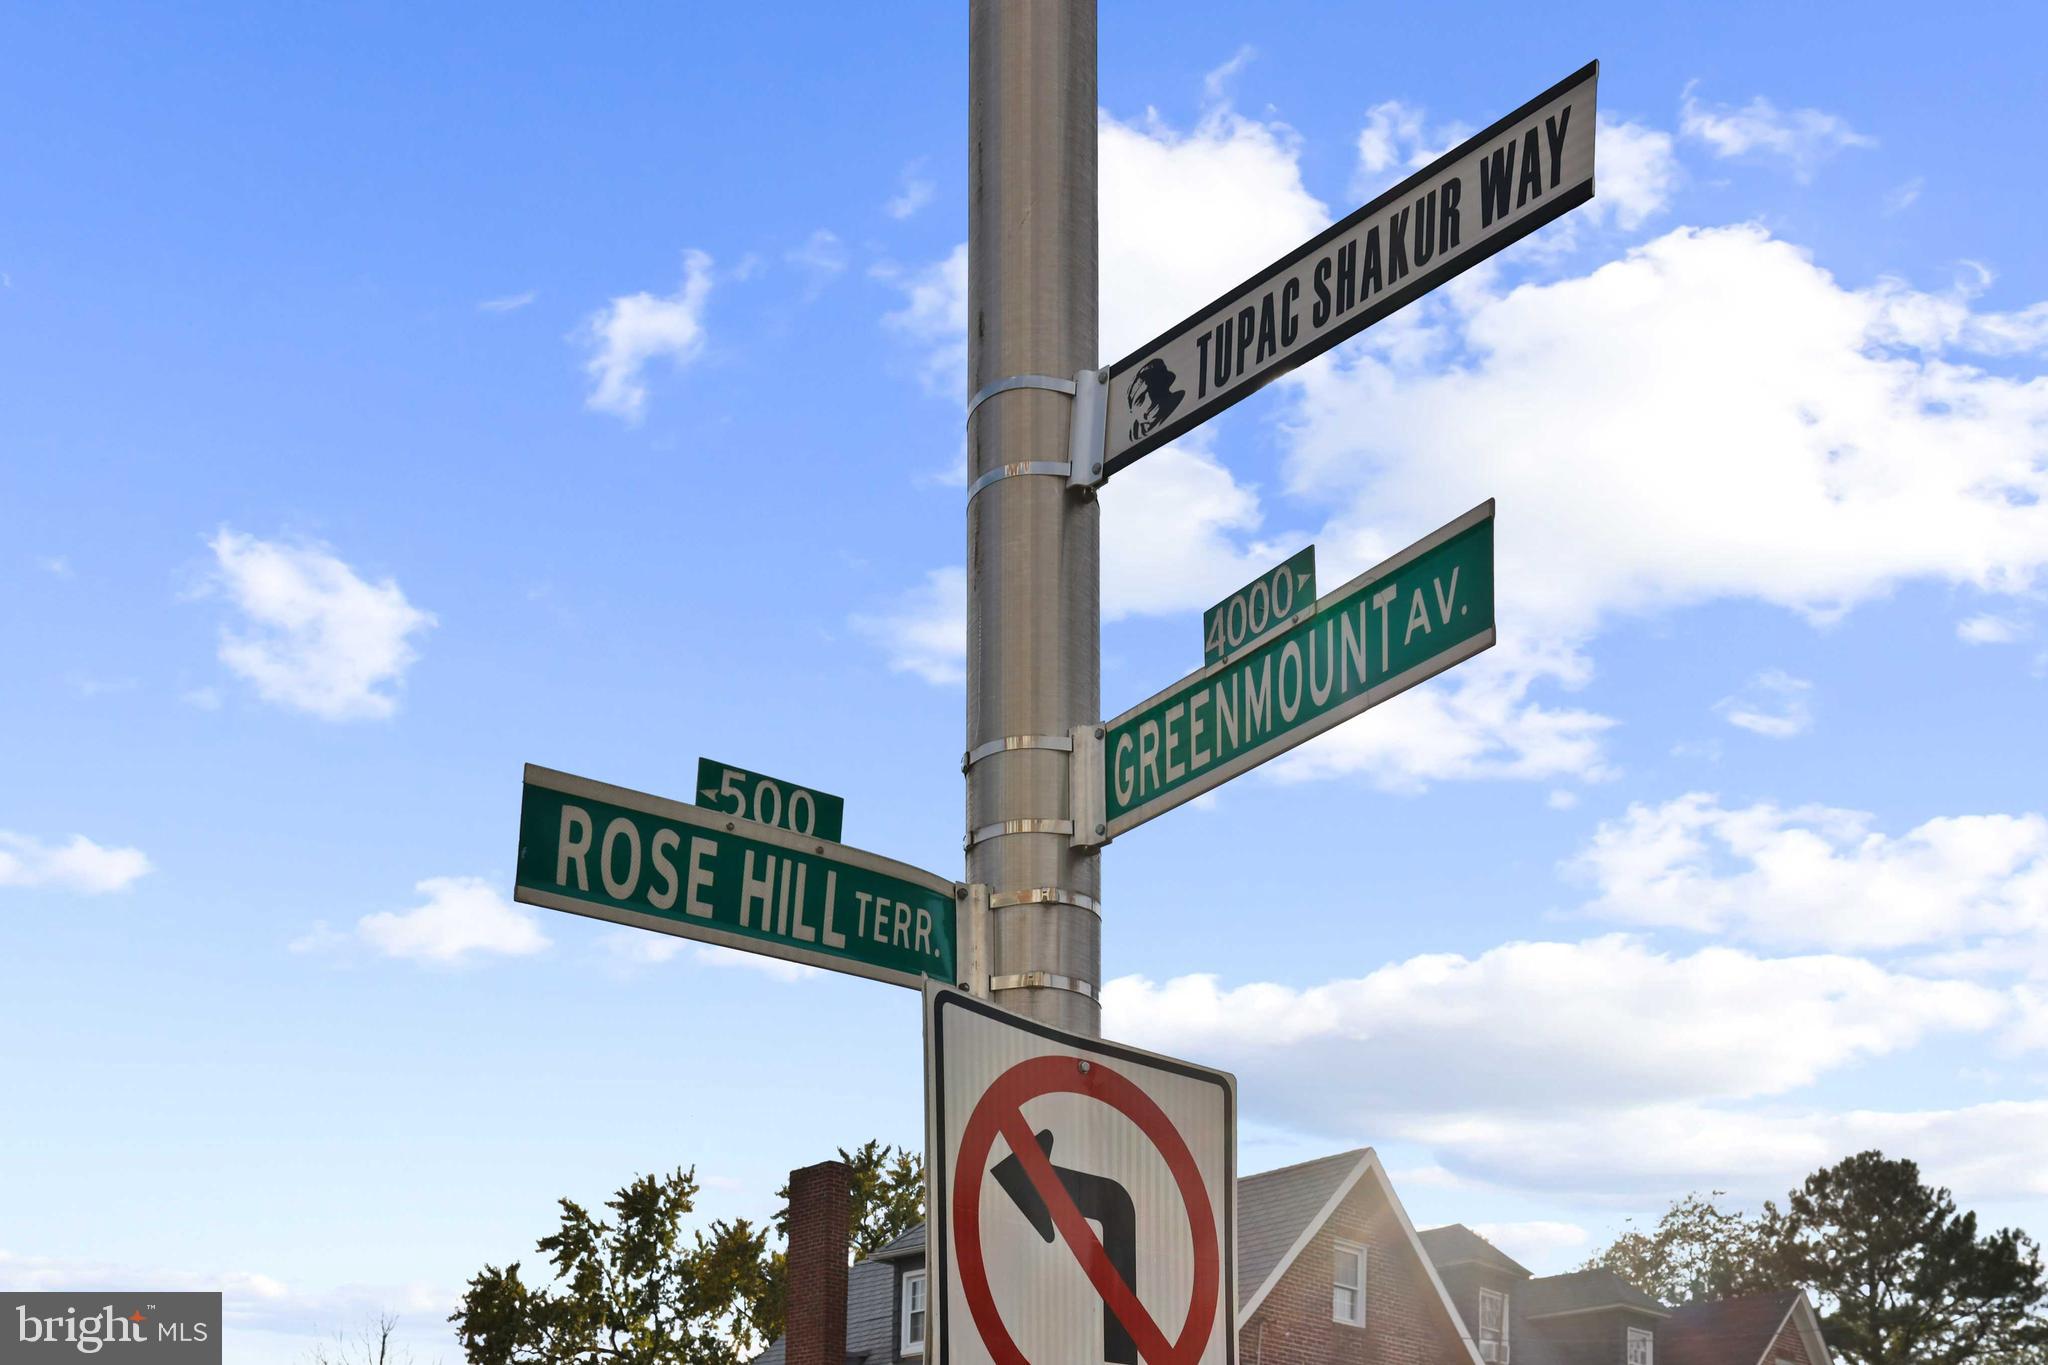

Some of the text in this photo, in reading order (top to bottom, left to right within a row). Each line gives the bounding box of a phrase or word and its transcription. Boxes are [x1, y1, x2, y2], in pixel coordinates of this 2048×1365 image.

[1196, 105, 1572, 399] TUPAC SHAKUR WAY
[1114, 566, 1468, 806] GREENMOUNT AV.
[1205, 565, 1293, 657] 4000
[720, 769, 816, 836] 500
[555, 804, 941, 958] ROSE HILL TERR.
